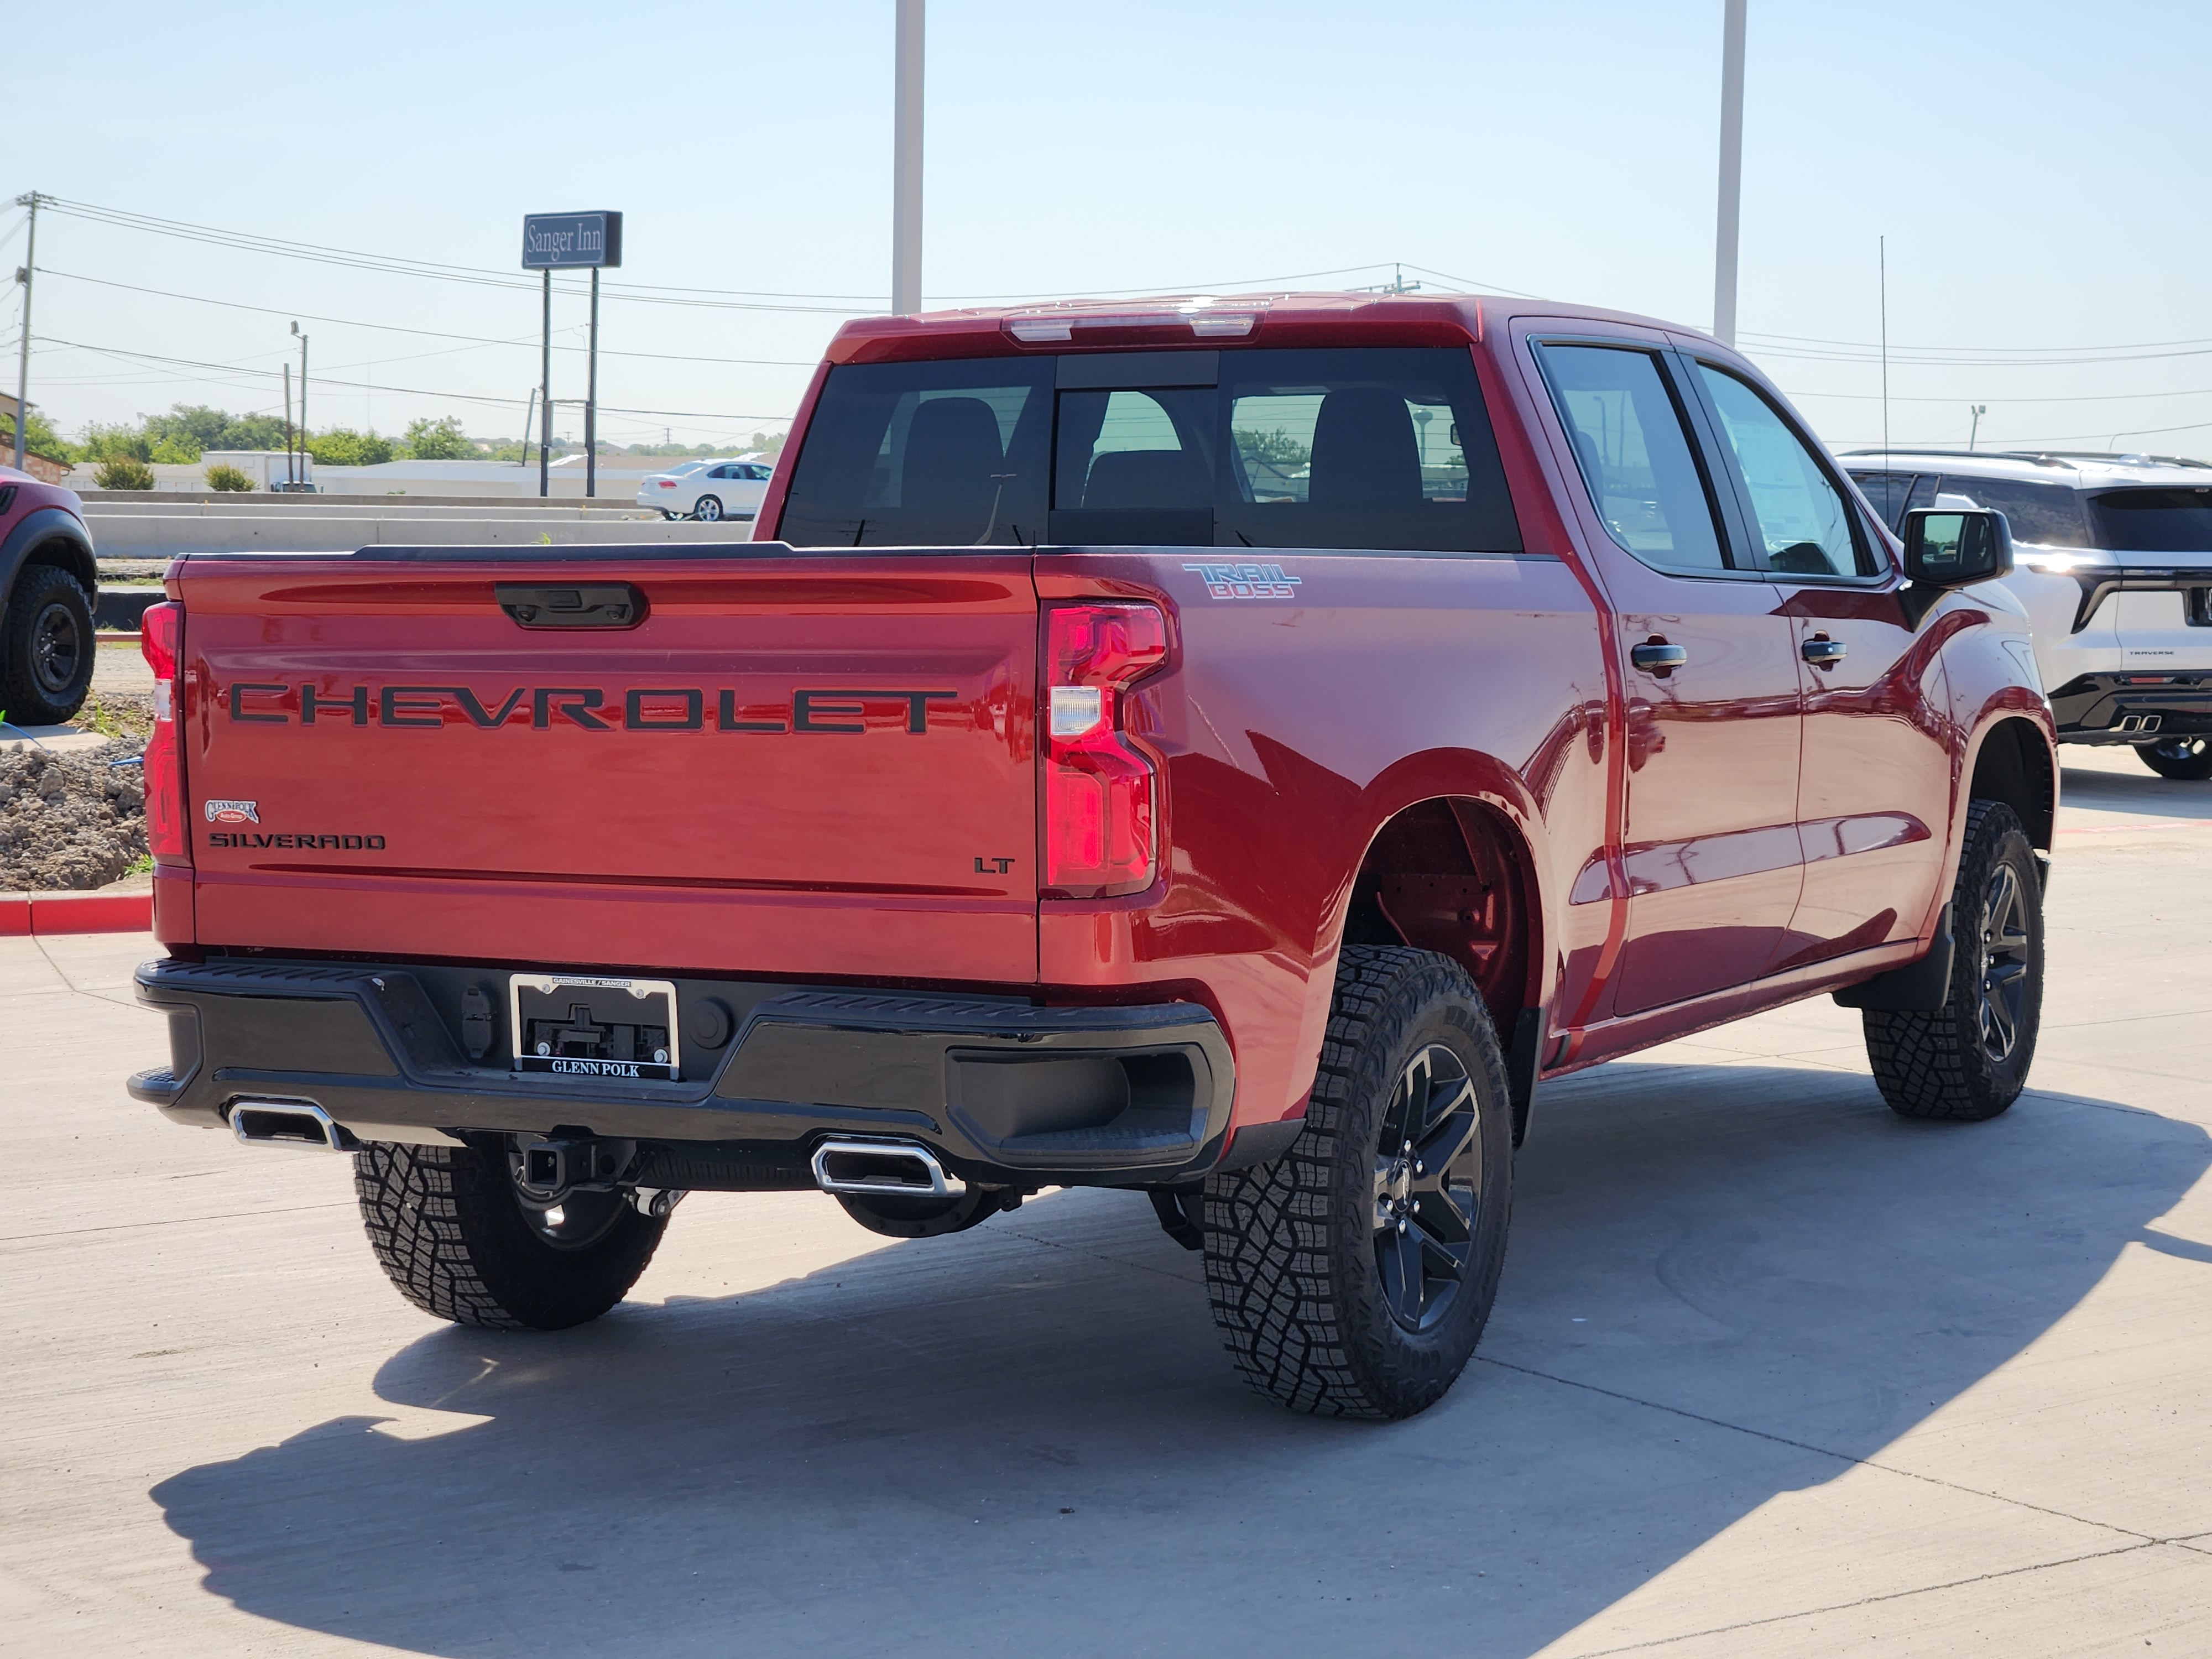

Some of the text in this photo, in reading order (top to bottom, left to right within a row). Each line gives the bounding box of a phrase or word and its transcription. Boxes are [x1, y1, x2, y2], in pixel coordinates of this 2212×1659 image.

[527, 222, 601, 262] Sanger Inn
[1181, 563, 1302, 584] TRAIL
[1209, 583, 1295, 599] BOSS
[229, 682, 958, 734] CHEVROLET
[207, 801, 257, 821] GLENN POLK
[209, 833, 386, 850] SILVERADO
[974, 857, 1015, 874] LT
[552, 1060, 640, 1077] GLENN POLK
